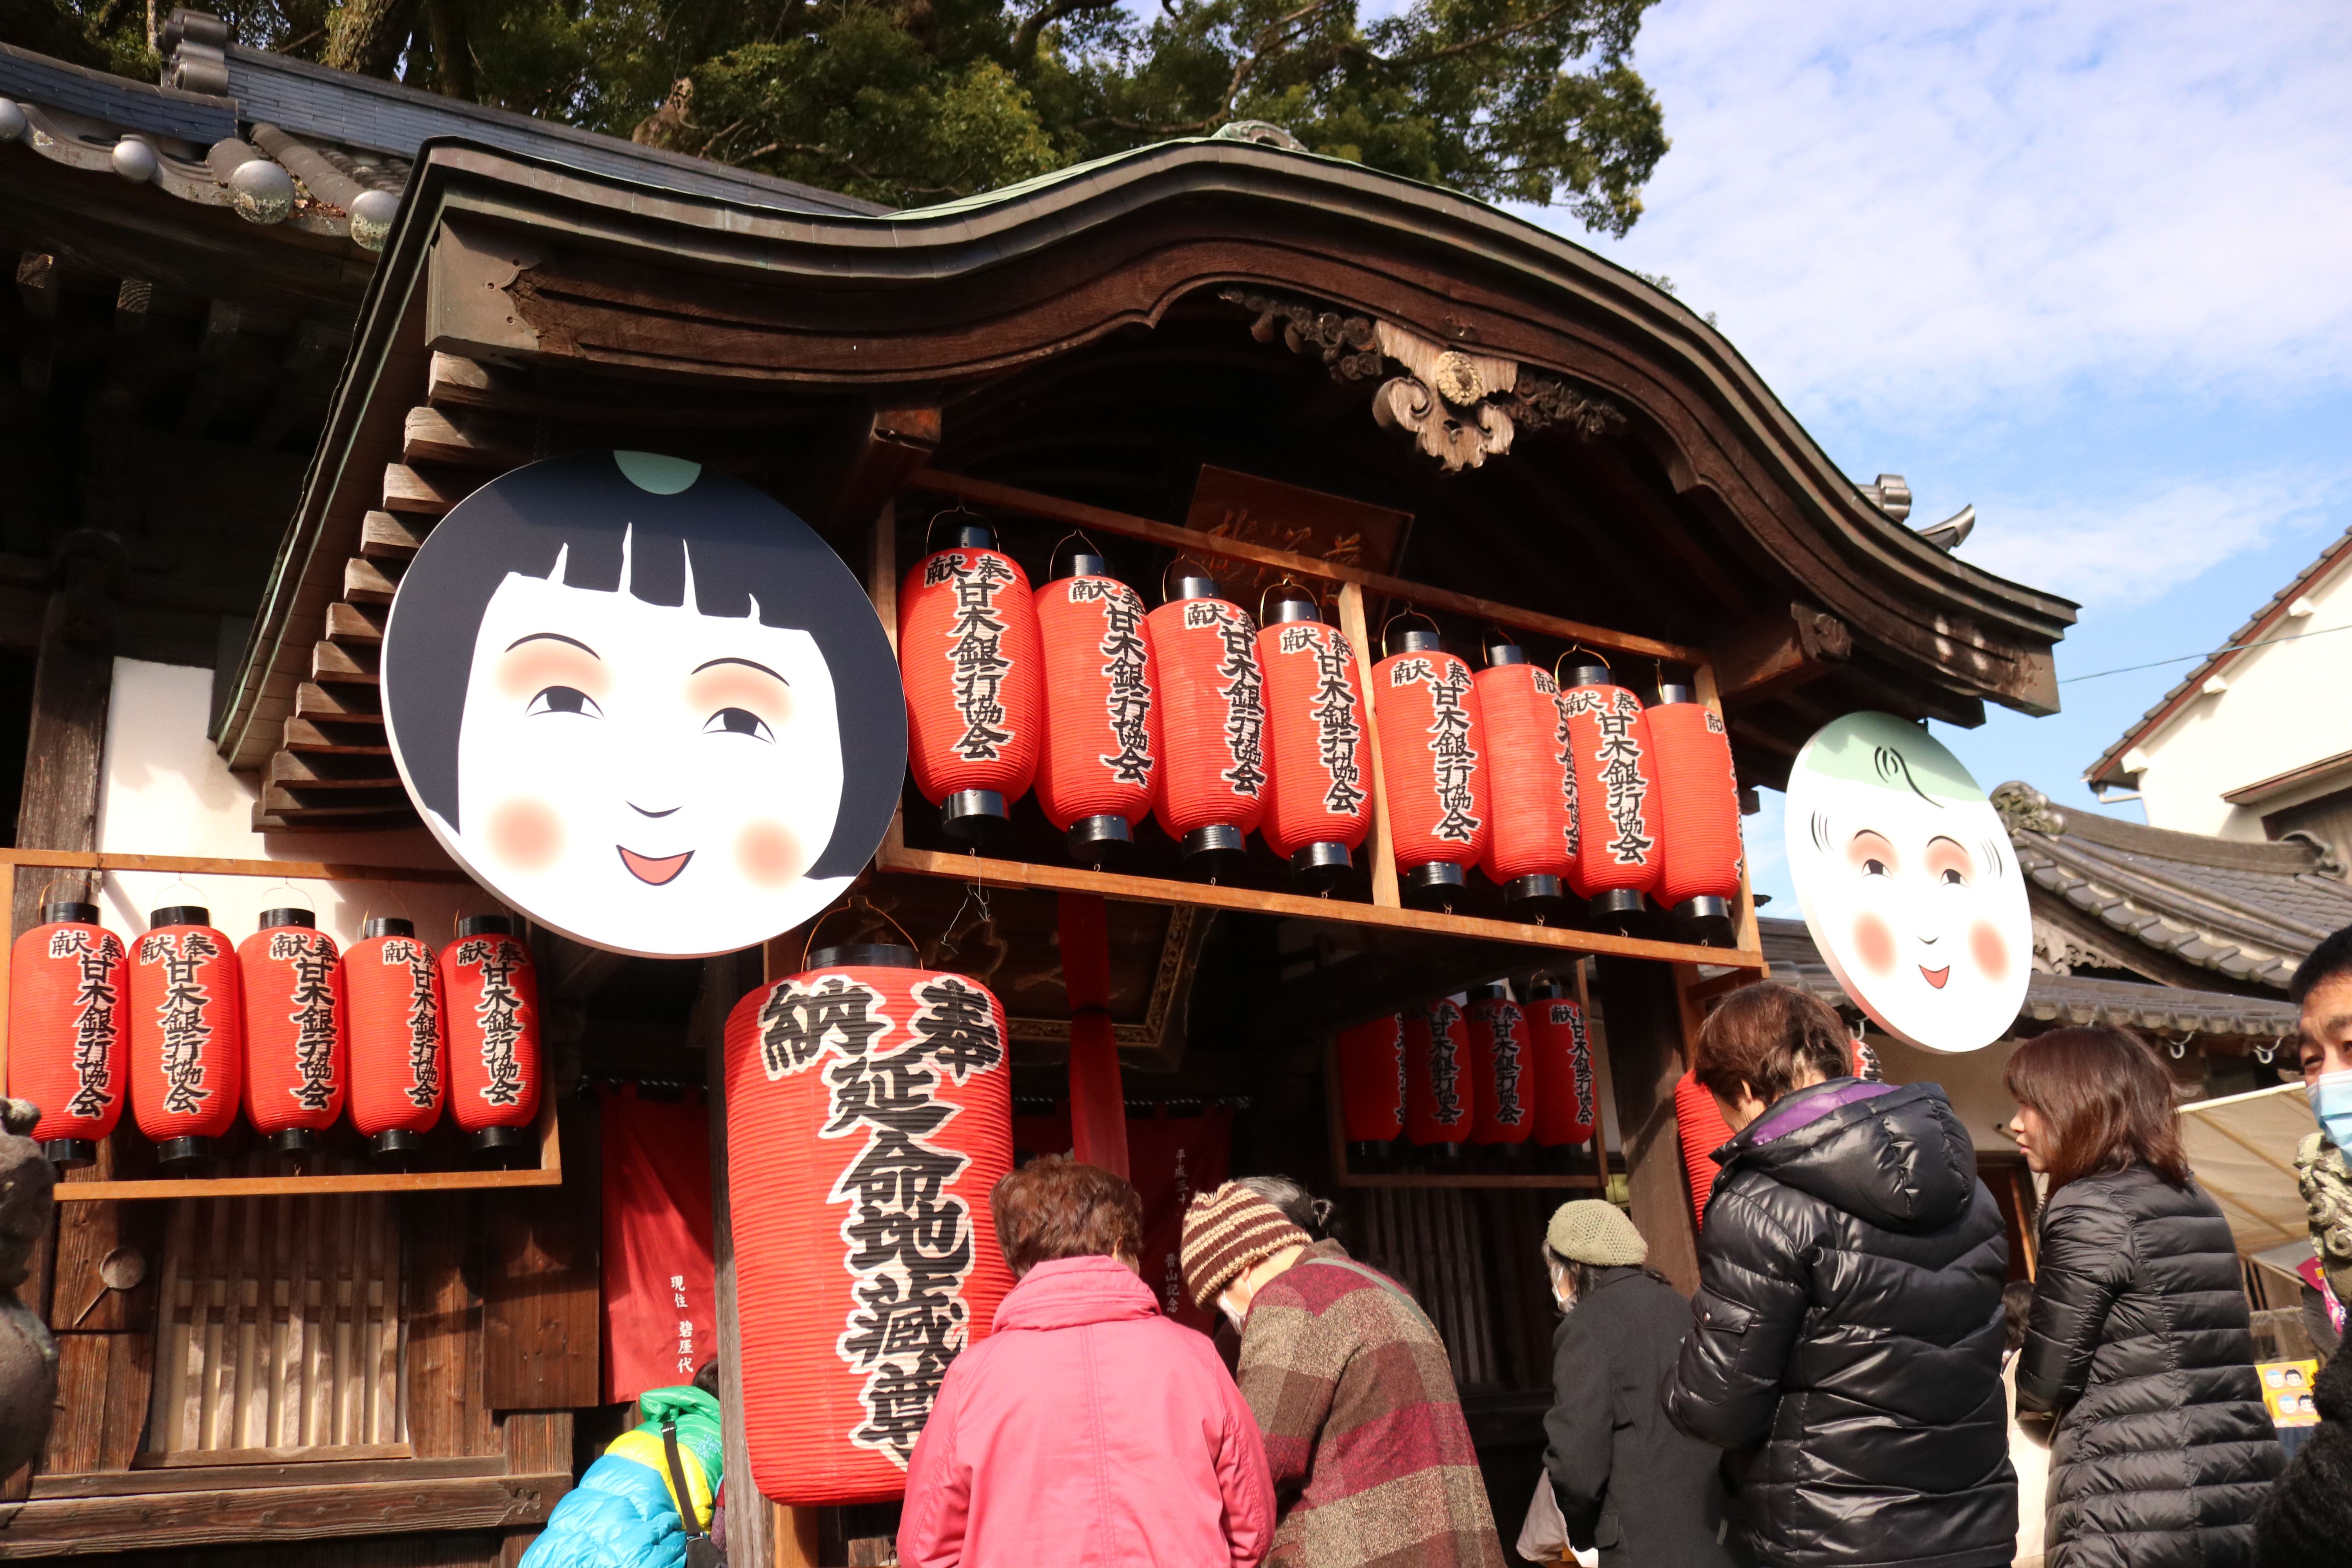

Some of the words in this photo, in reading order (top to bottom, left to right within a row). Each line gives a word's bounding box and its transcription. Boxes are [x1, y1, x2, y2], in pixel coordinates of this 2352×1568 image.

[950, 577, 1009, 759] 甘木銀行協会
[1103, 603, 1152, 784] 甘木銀行協会
[1221, 627, 1265, 794] 甘木銀行協会
[1314, 649, 1364, 813] 甘木銀行協会
[1433, 682, 1478, 840] 甘木銀行協会
[1599, 712, 1651, 863] 甘木銀行協会
[73, 955, 116, 1116] 甘木銀行協会
[160, 957, 211, 1112] 甘木銀行協会
[293, 958, 337, 1108] 甘木銀行協会
[408, 965, 438, 1105] 甘木銀行協会
[478, 962, 524, 1103] 甘木銀行協会
[1429, 1020, 1462, 1123] 甘木銀行協会
[1494, 1021, 1523, 1123] 甘木銀行協会
[1571, 1022, 1593, 1123] 甘木銀行協会
[670, 1275, 688, 1308] 現住
